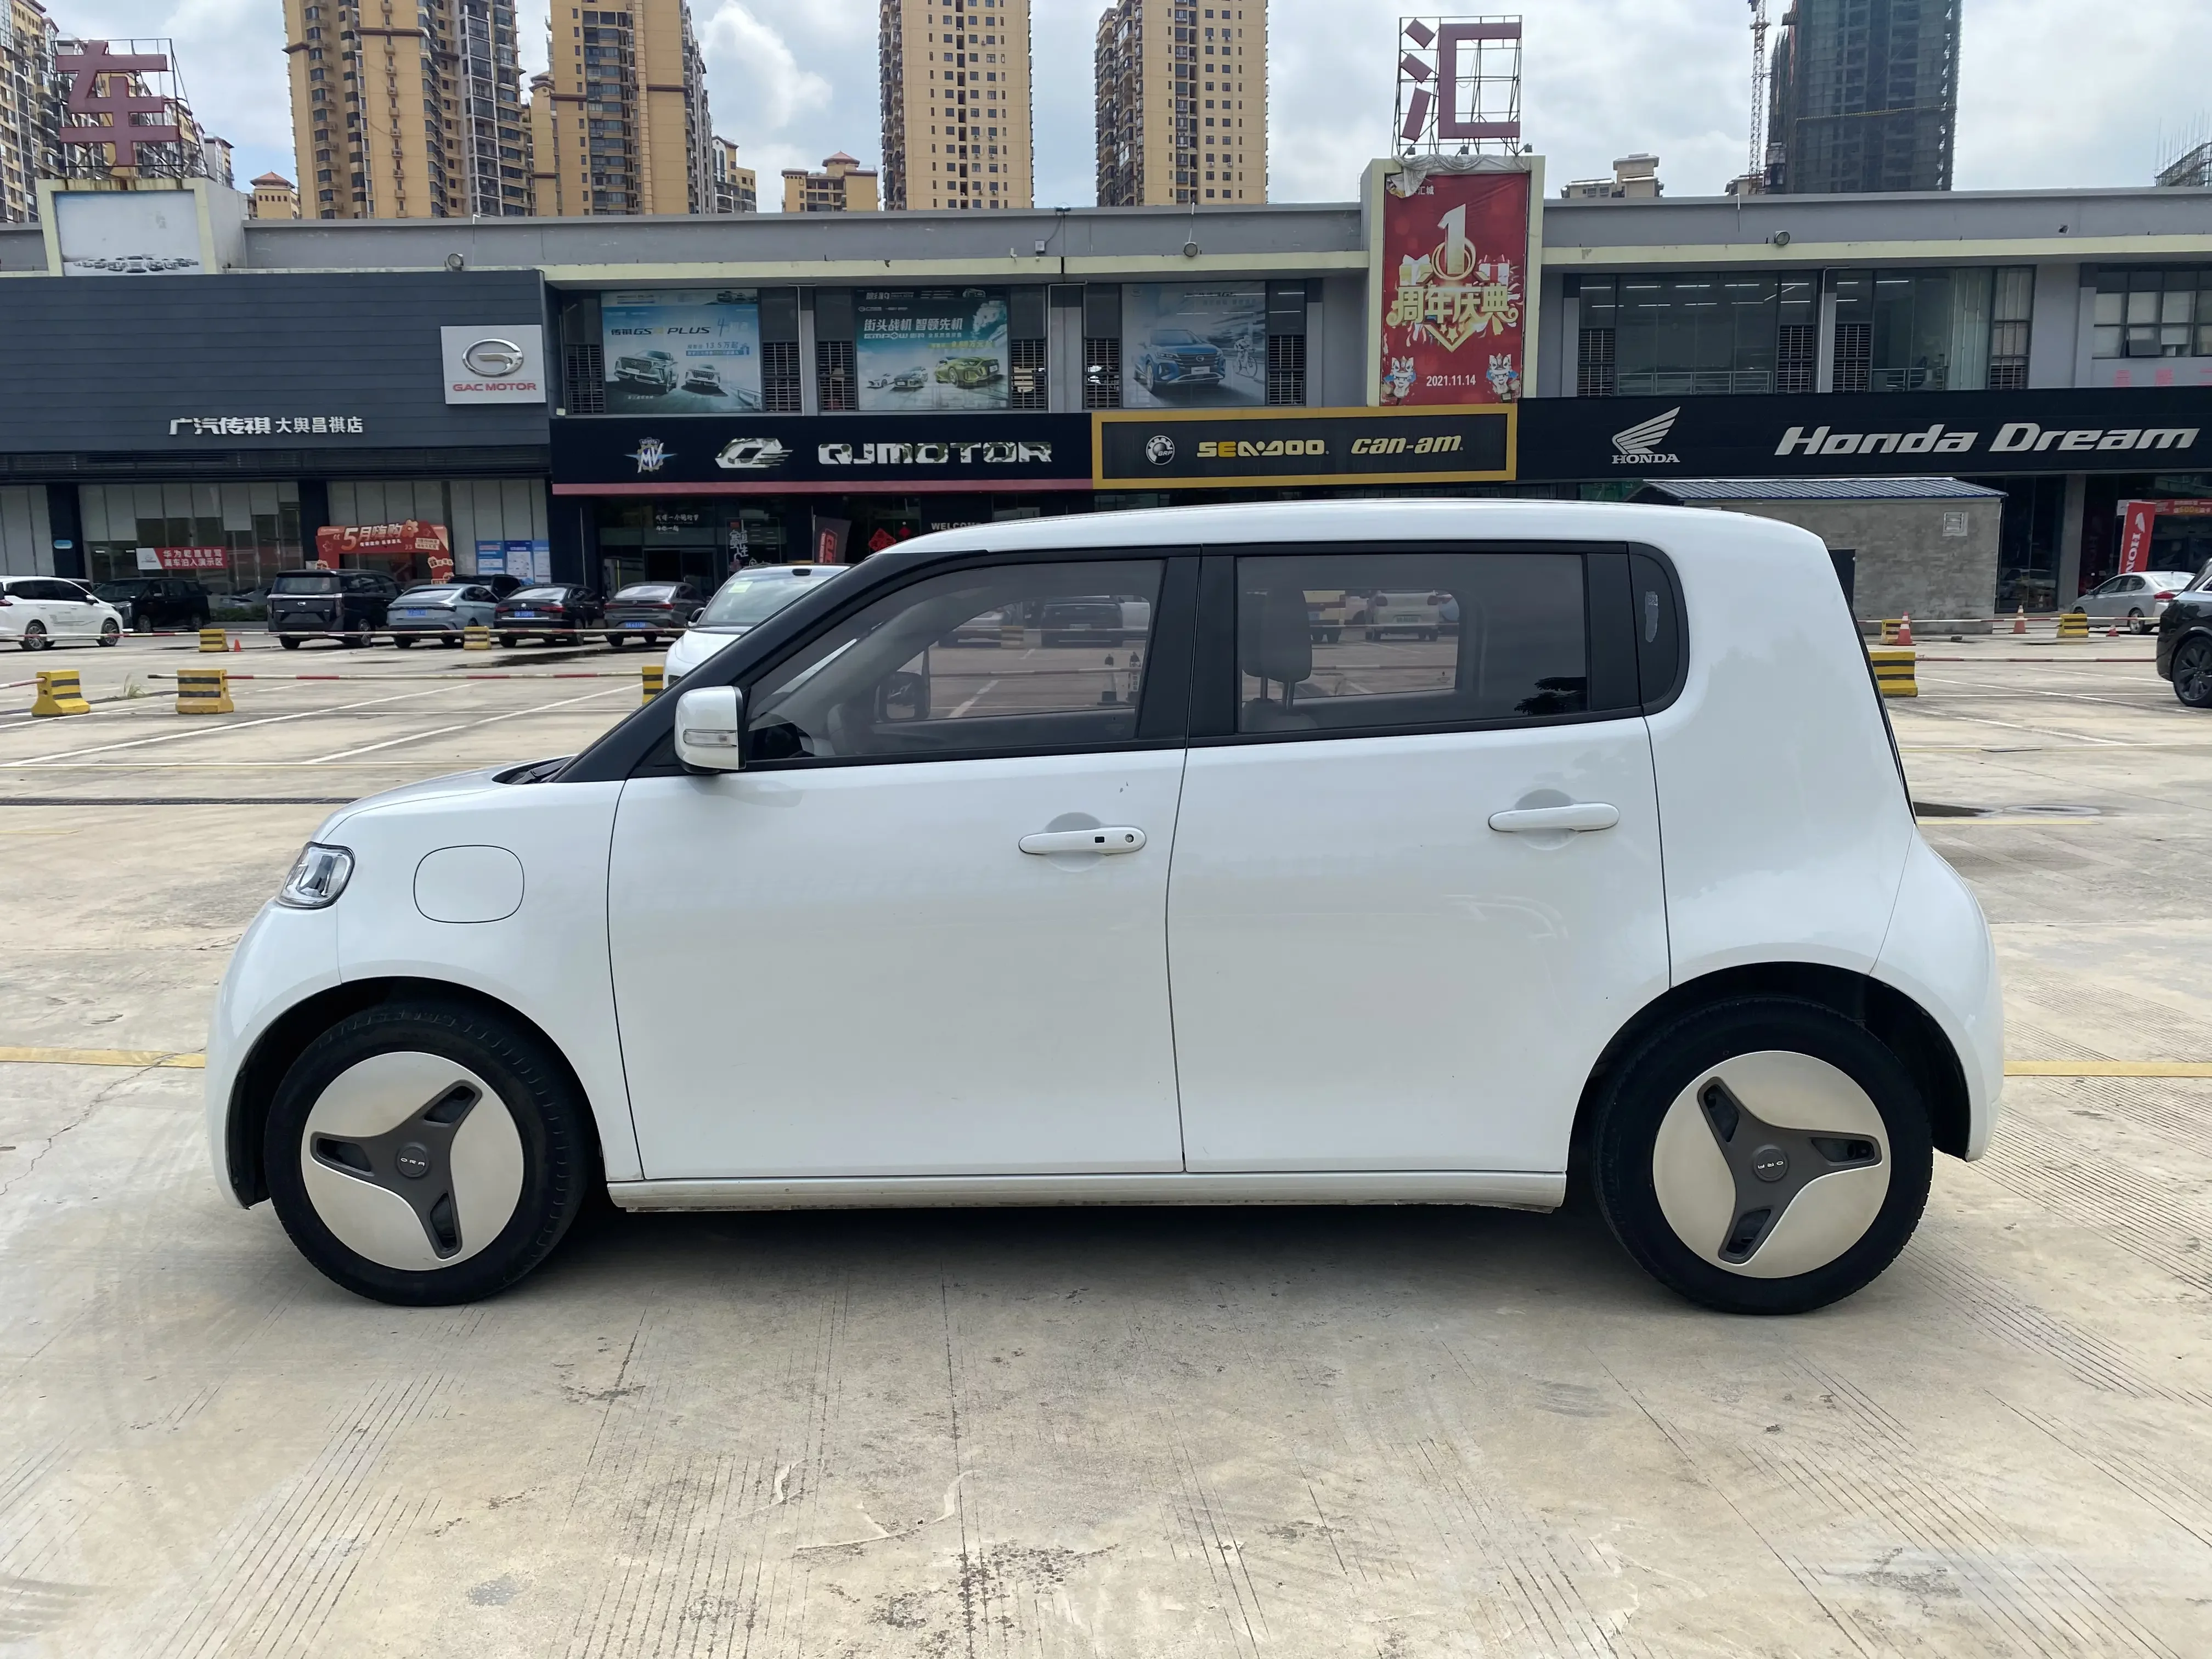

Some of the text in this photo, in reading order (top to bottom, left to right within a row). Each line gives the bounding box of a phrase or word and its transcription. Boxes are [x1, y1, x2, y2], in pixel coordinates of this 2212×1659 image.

[1401, 18, 1521, 142] 汇
[55, 40, 180, 166] 车
[1414, 185, 1435, 195] 汇城
[1397, 283, 1509, 324] 周年庆典
[667, 326, 710, 335] PLUS
[864, 318, 963, 332] 街头战机 智领先机
[453, 382, 537, 392] GAC MOTOR
[1426, 374, 1476, 387] 2021.11.14
[169, 417, 272, 436] 广汽传祺
[1774, 422, 2200, 456] Honda Dream
[817, 441, 1053, 465] QJMOTOR
[1611, 453, 1680, 464] HONDA
[931, 522, 981, 531] WELCO
[341, 522, 403, 551] 5月嗨购
[2125, 532, 2142, 574] HON
[400, 1158, 425, 1166] ORA
